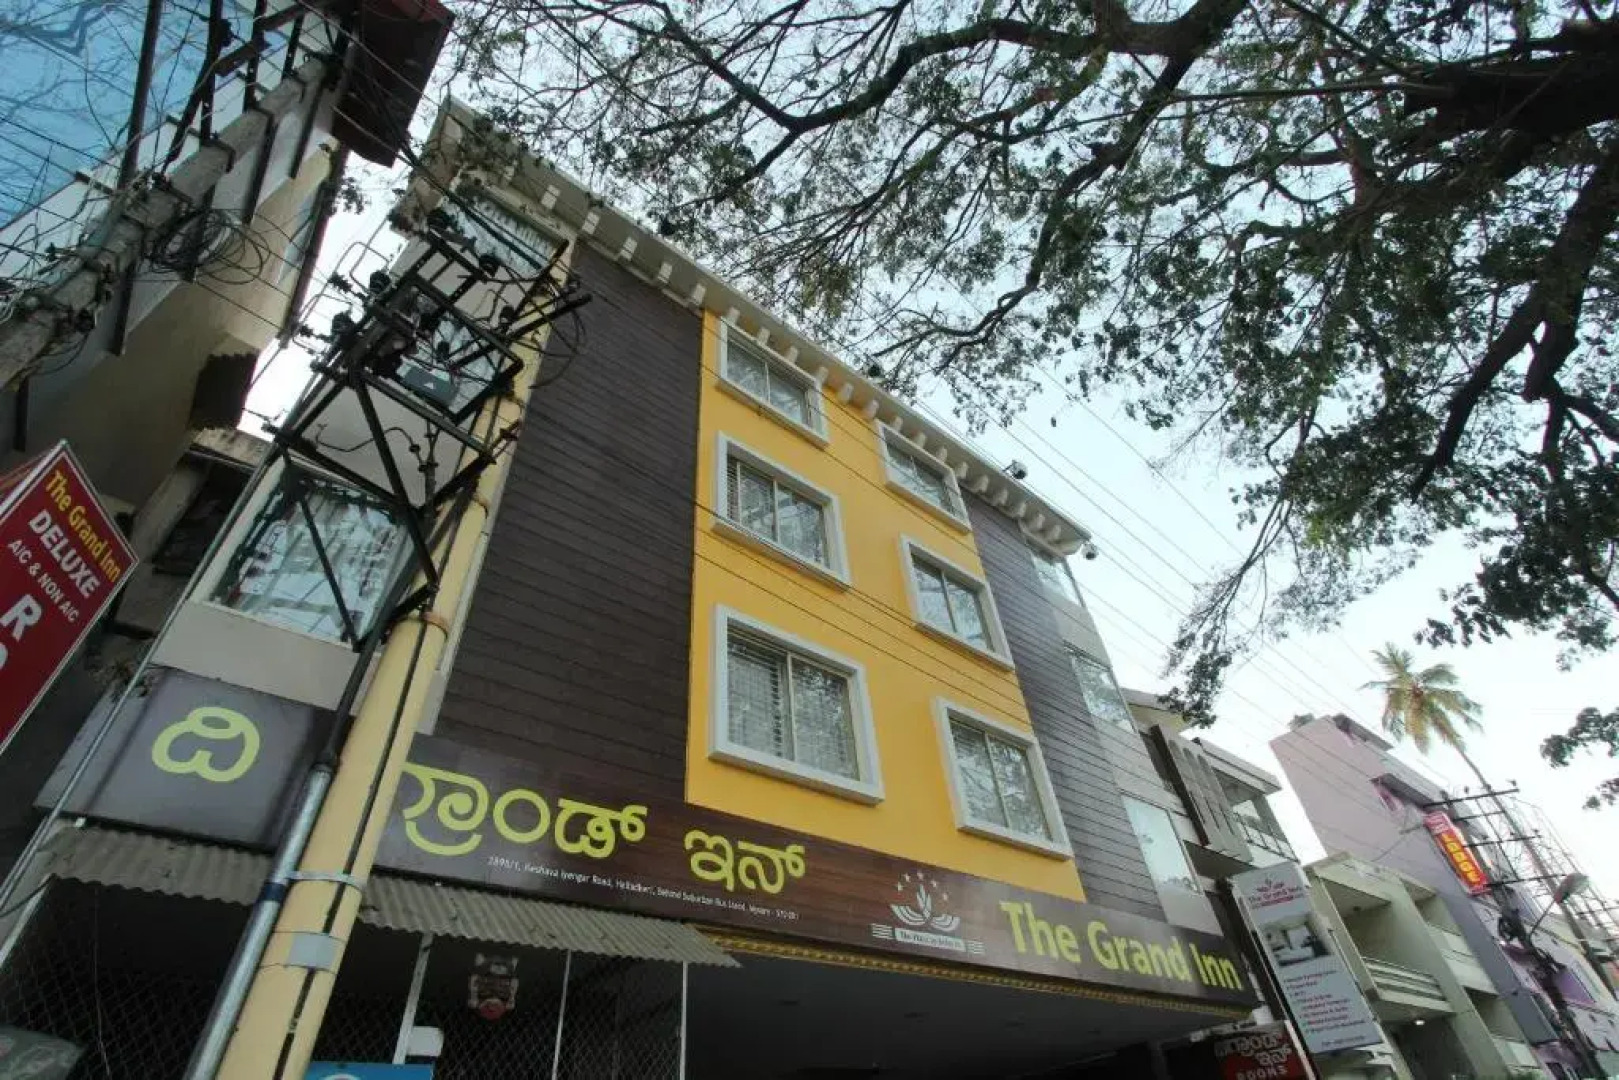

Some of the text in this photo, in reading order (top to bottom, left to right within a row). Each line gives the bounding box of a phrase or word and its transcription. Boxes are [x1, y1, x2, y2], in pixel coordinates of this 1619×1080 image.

[28, 508, 101, 598] DELUXE
[45, 469, 121, 583] The Grand Inn
[8, 540, 80, 623] A/C & NON A/C
[684, 829, 806, 895] ಇನ್
[1000, 901, 1246, 991] The Grand Inn
